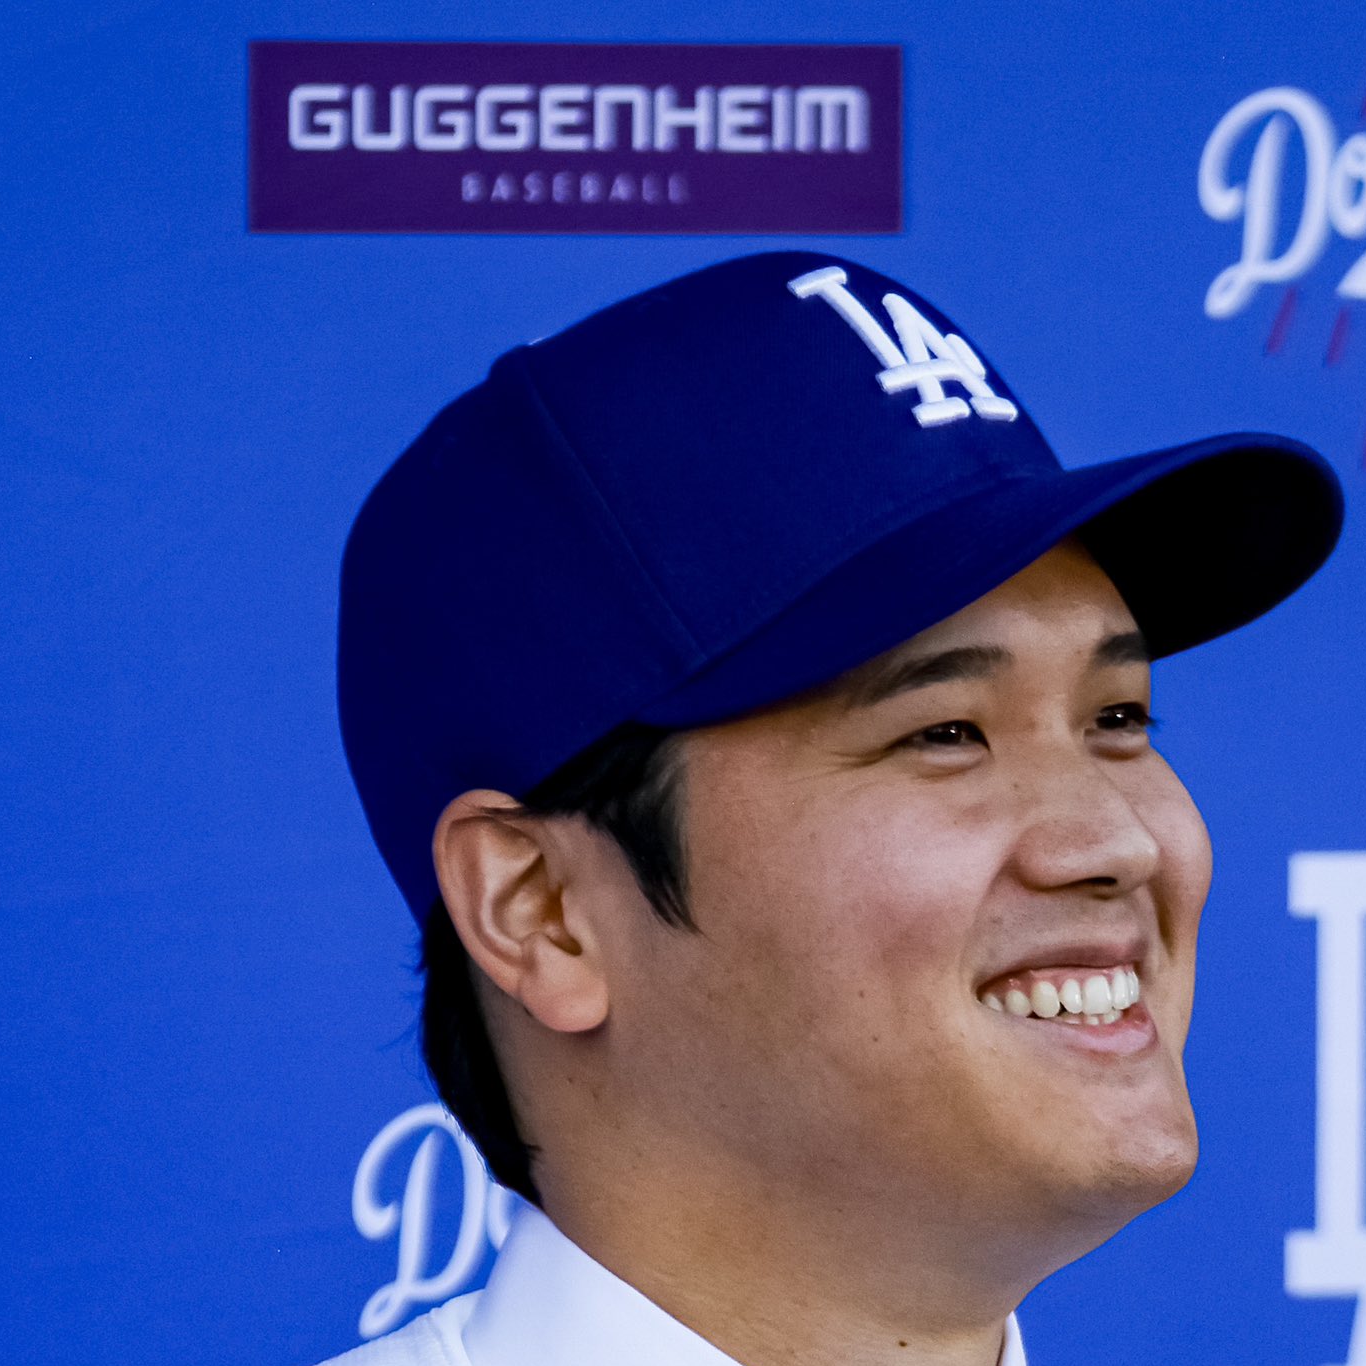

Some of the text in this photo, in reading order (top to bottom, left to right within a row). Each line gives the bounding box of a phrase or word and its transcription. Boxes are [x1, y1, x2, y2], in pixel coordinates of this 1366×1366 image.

[289, 86, 869, 152] GUGGENHEIM
[461, 173, 684, 201] BASEBALL
[787, 266, 1018, 428] LA
